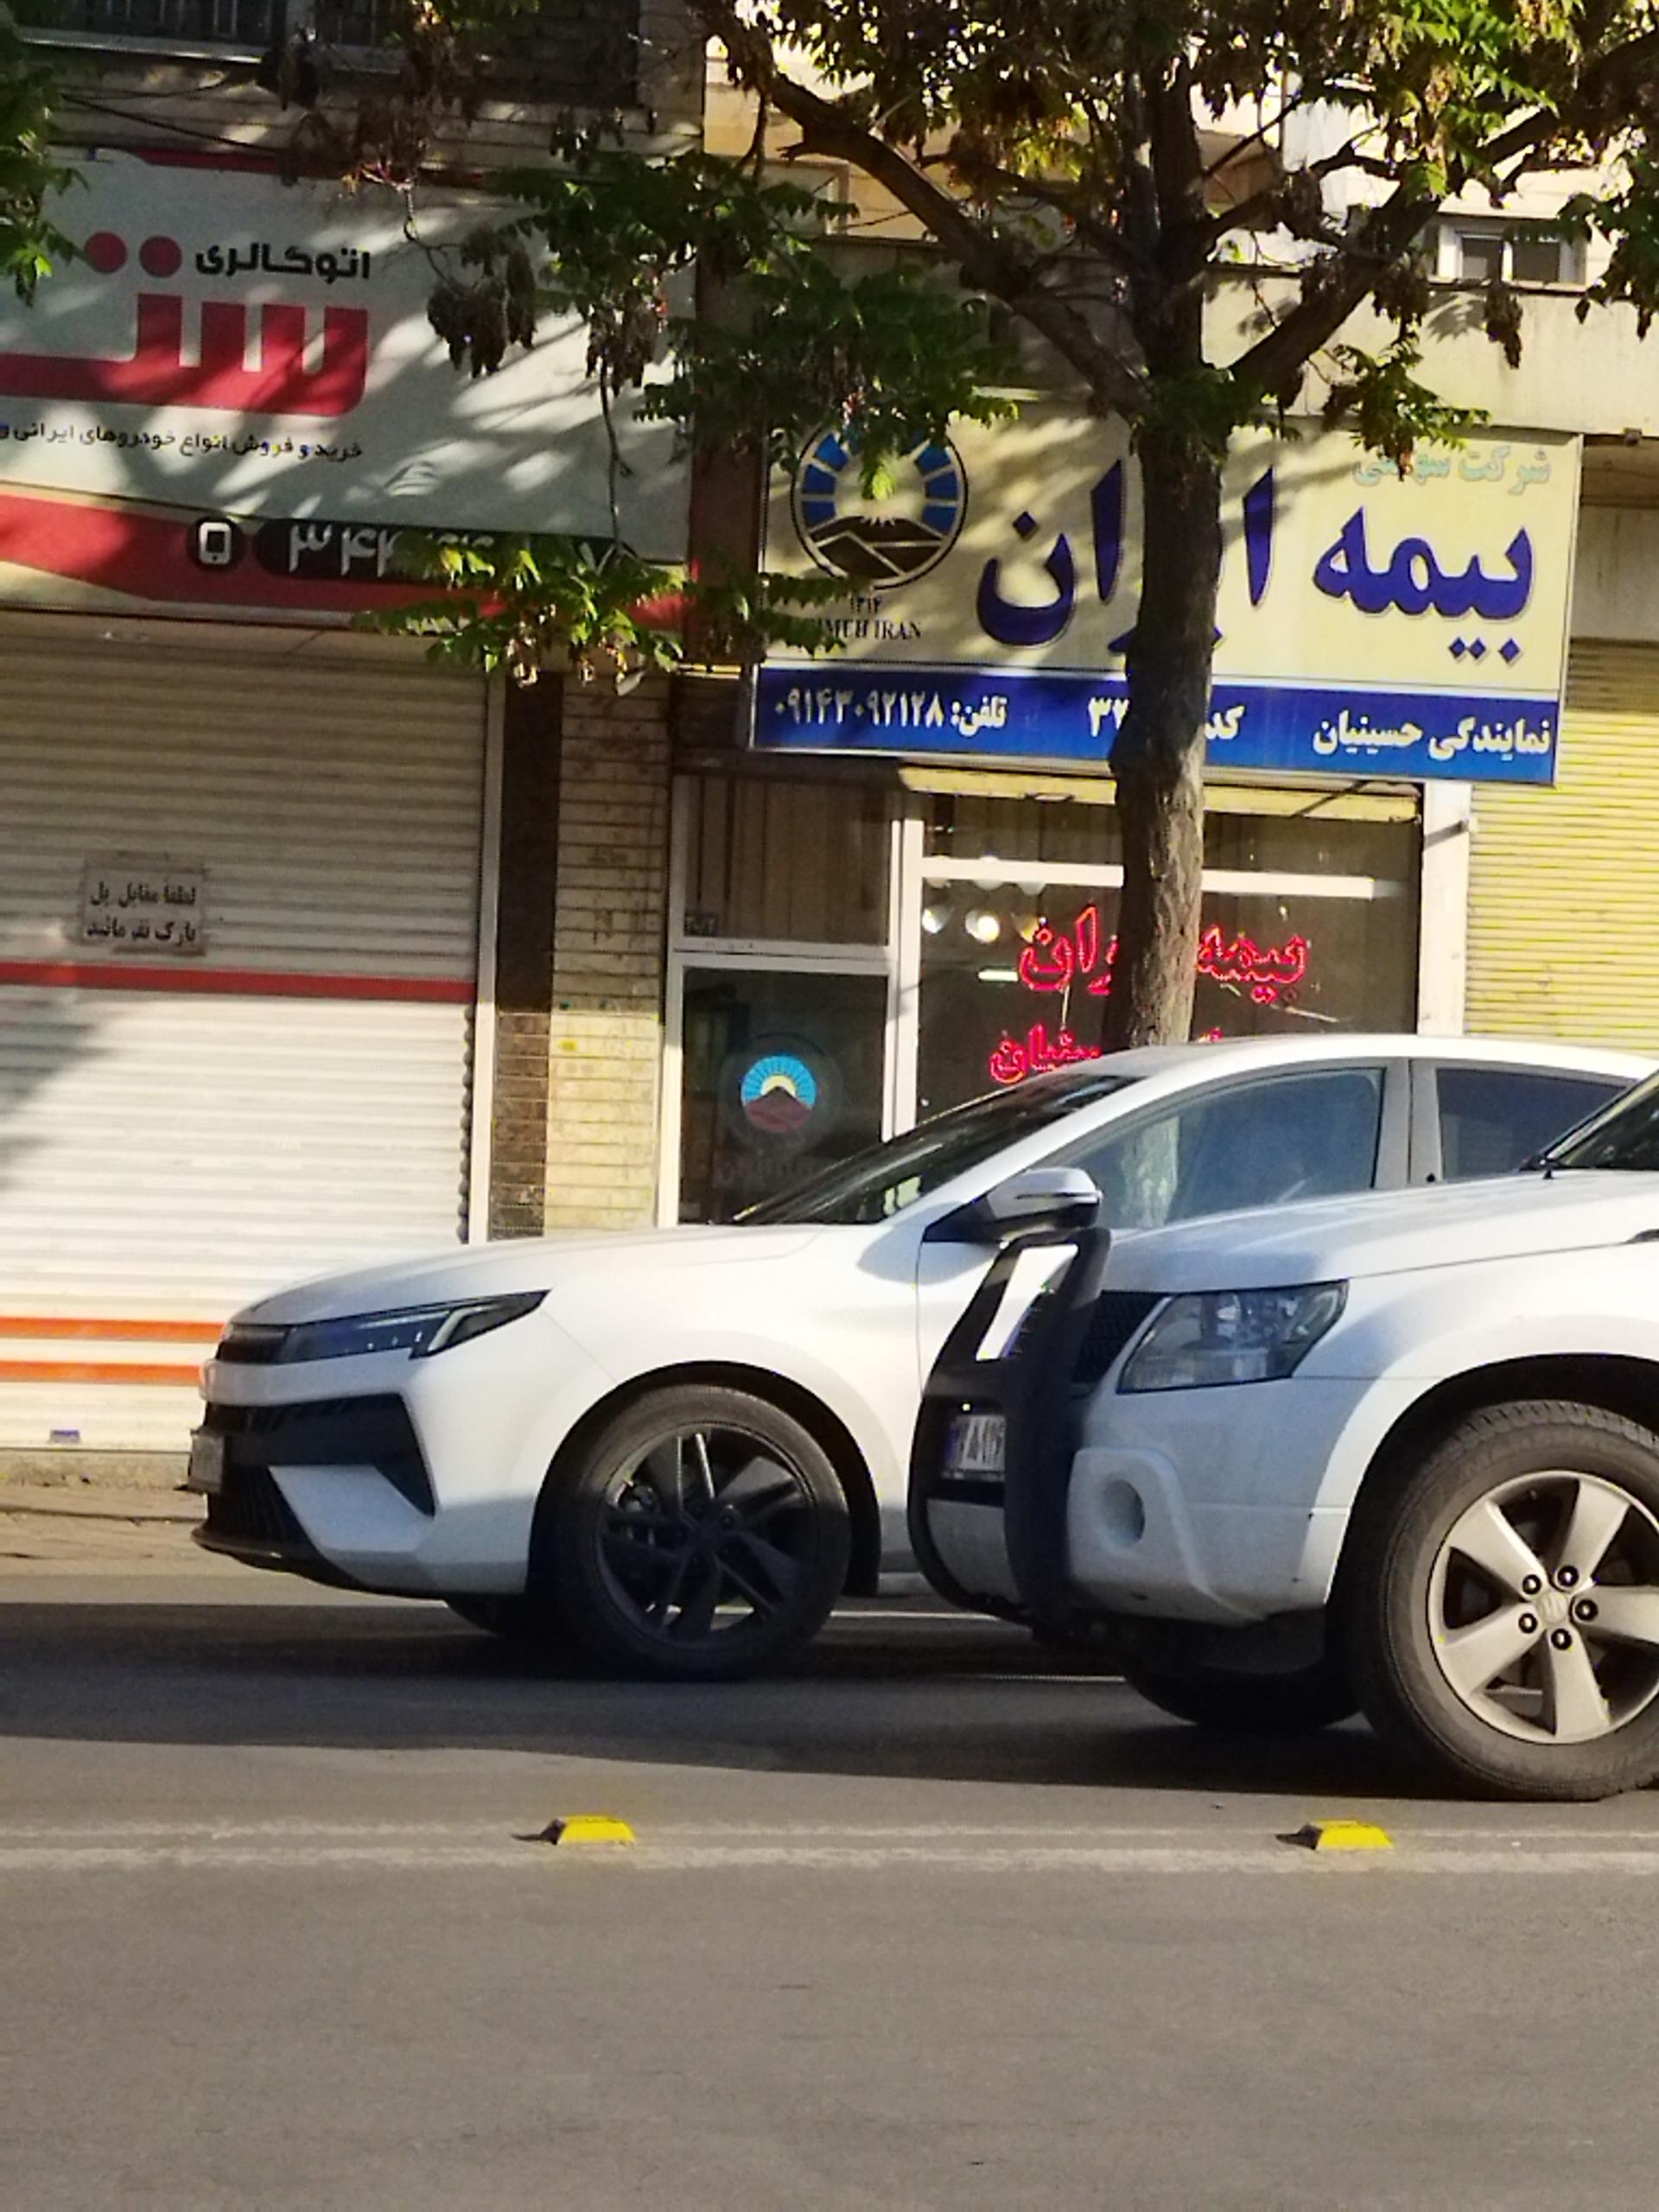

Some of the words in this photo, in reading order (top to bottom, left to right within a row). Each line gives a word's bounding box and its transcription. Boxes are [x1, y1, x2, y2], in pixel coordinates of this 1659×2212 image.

[14, 423, 75, 445] ایرانی
[79, 425, 176, 449] خودروهای
[179, 433, 228, 457] انواع
[232, 434, 294, 458] فروش
[298, 444, 309, 460] و
[315, 442, 363, 462] خرید
[1312, 505, 1535, 665] بیمه
[874, 620, 922, 640] IRAN
[1313, 709, 1424, 754] حسینیان
[1428, 716, 1552, 761] نمایندگی
